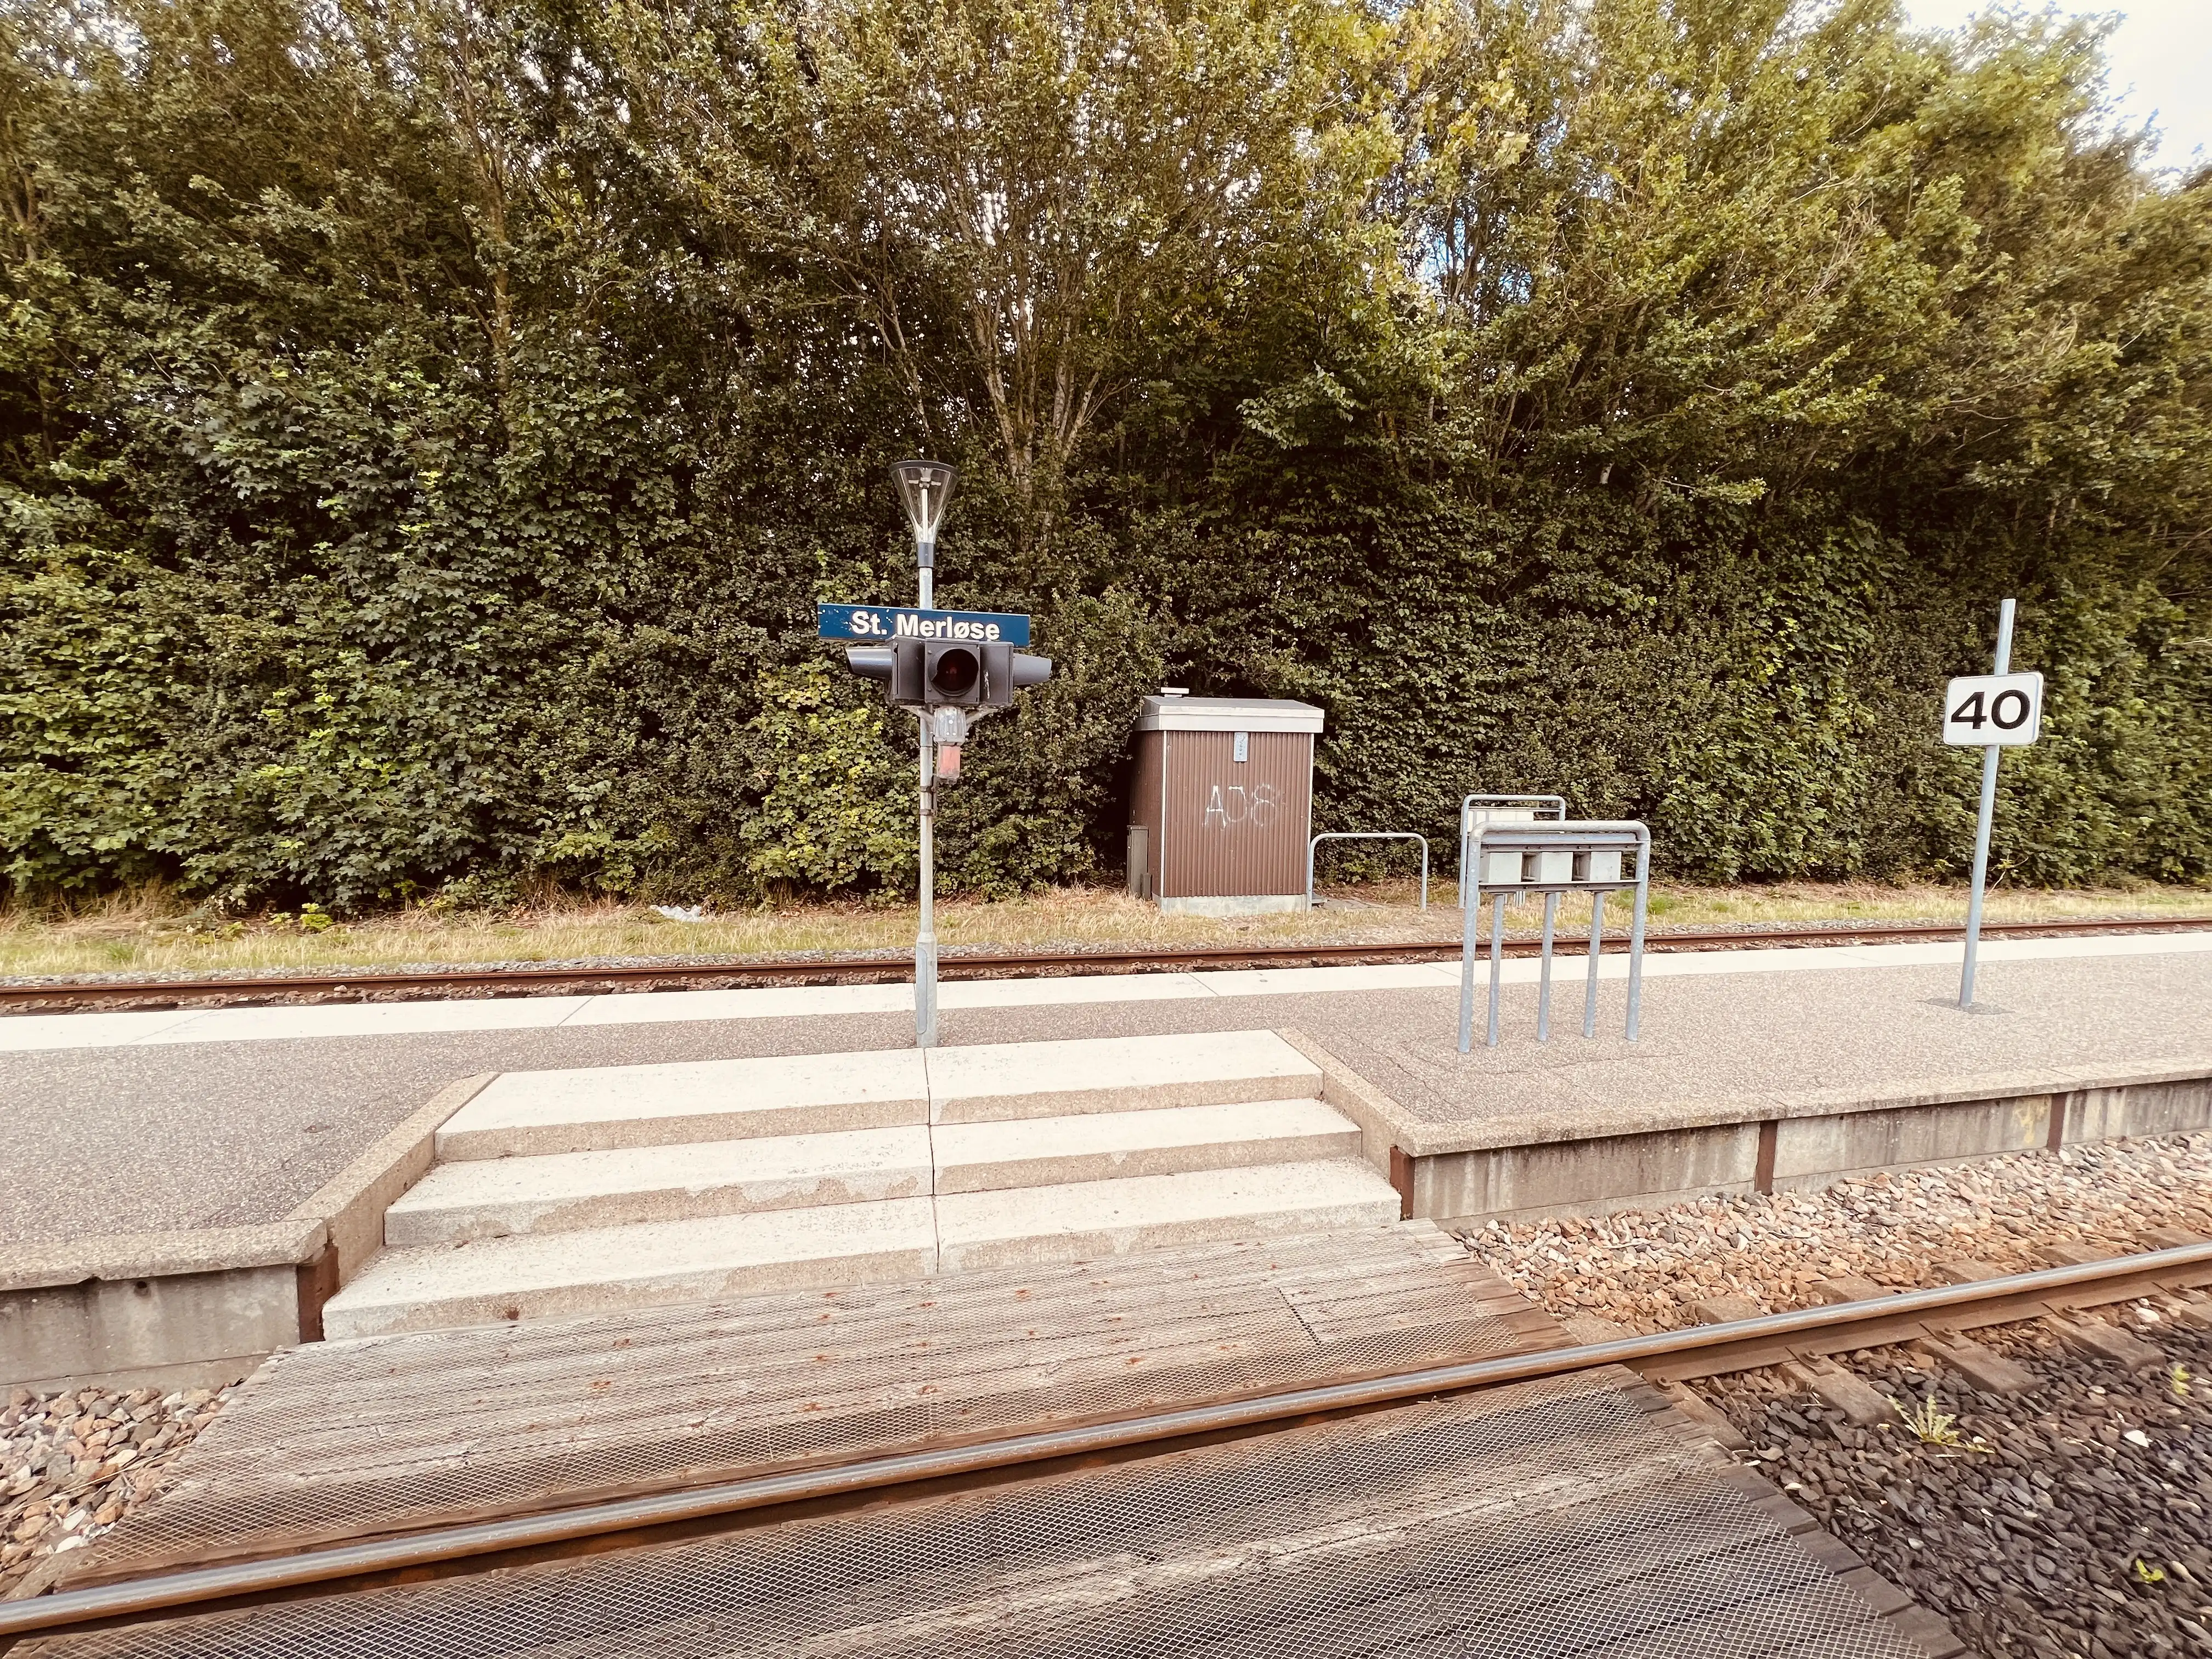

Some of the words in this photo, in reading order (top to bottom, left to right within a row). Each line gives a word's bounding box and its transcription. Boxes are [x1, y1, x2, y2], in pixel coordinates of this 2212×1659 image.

[851, 610, 888, 635] St.
[896, 613, 1001, 641] Merløse
[1950, 689, 2030, 730] 40
